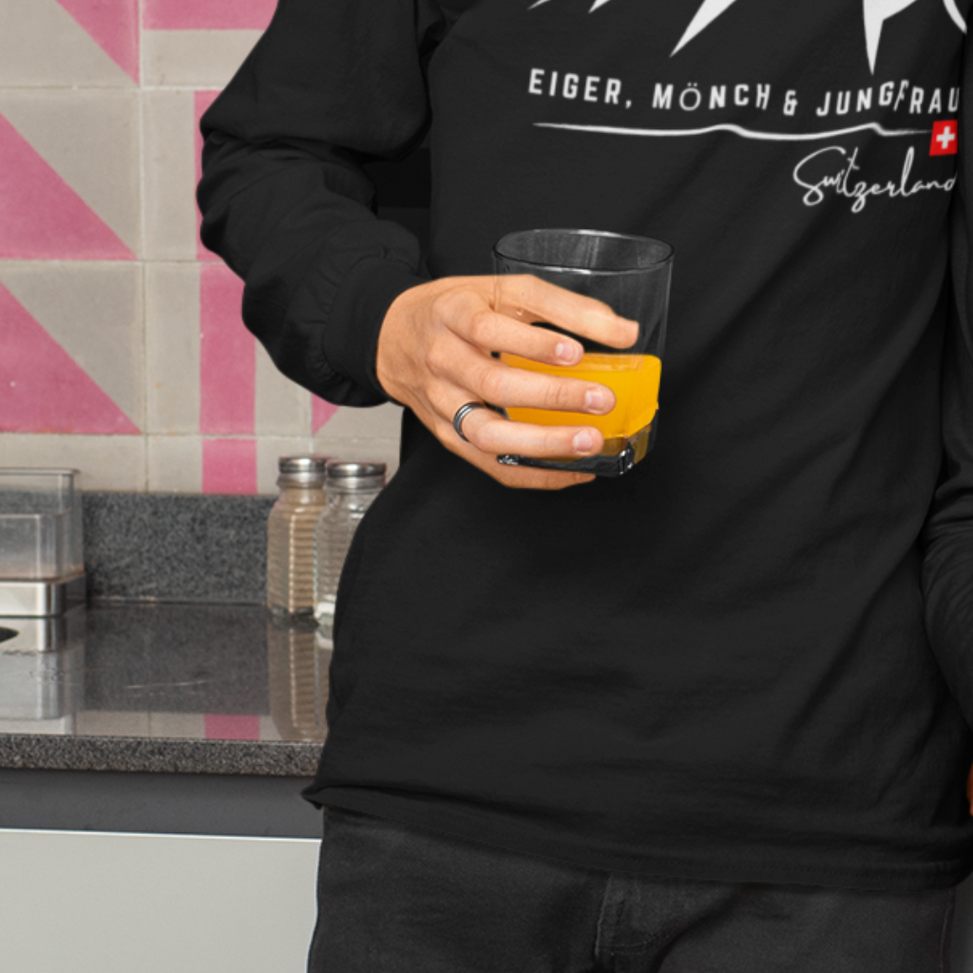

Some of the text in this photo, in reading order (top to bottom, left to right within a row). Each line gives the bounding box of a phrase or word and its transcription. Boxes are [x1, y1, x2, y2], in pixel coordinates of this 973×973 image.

[528, 68, 960, 117] EIGER, MÖNCH & JUNGFRAU
